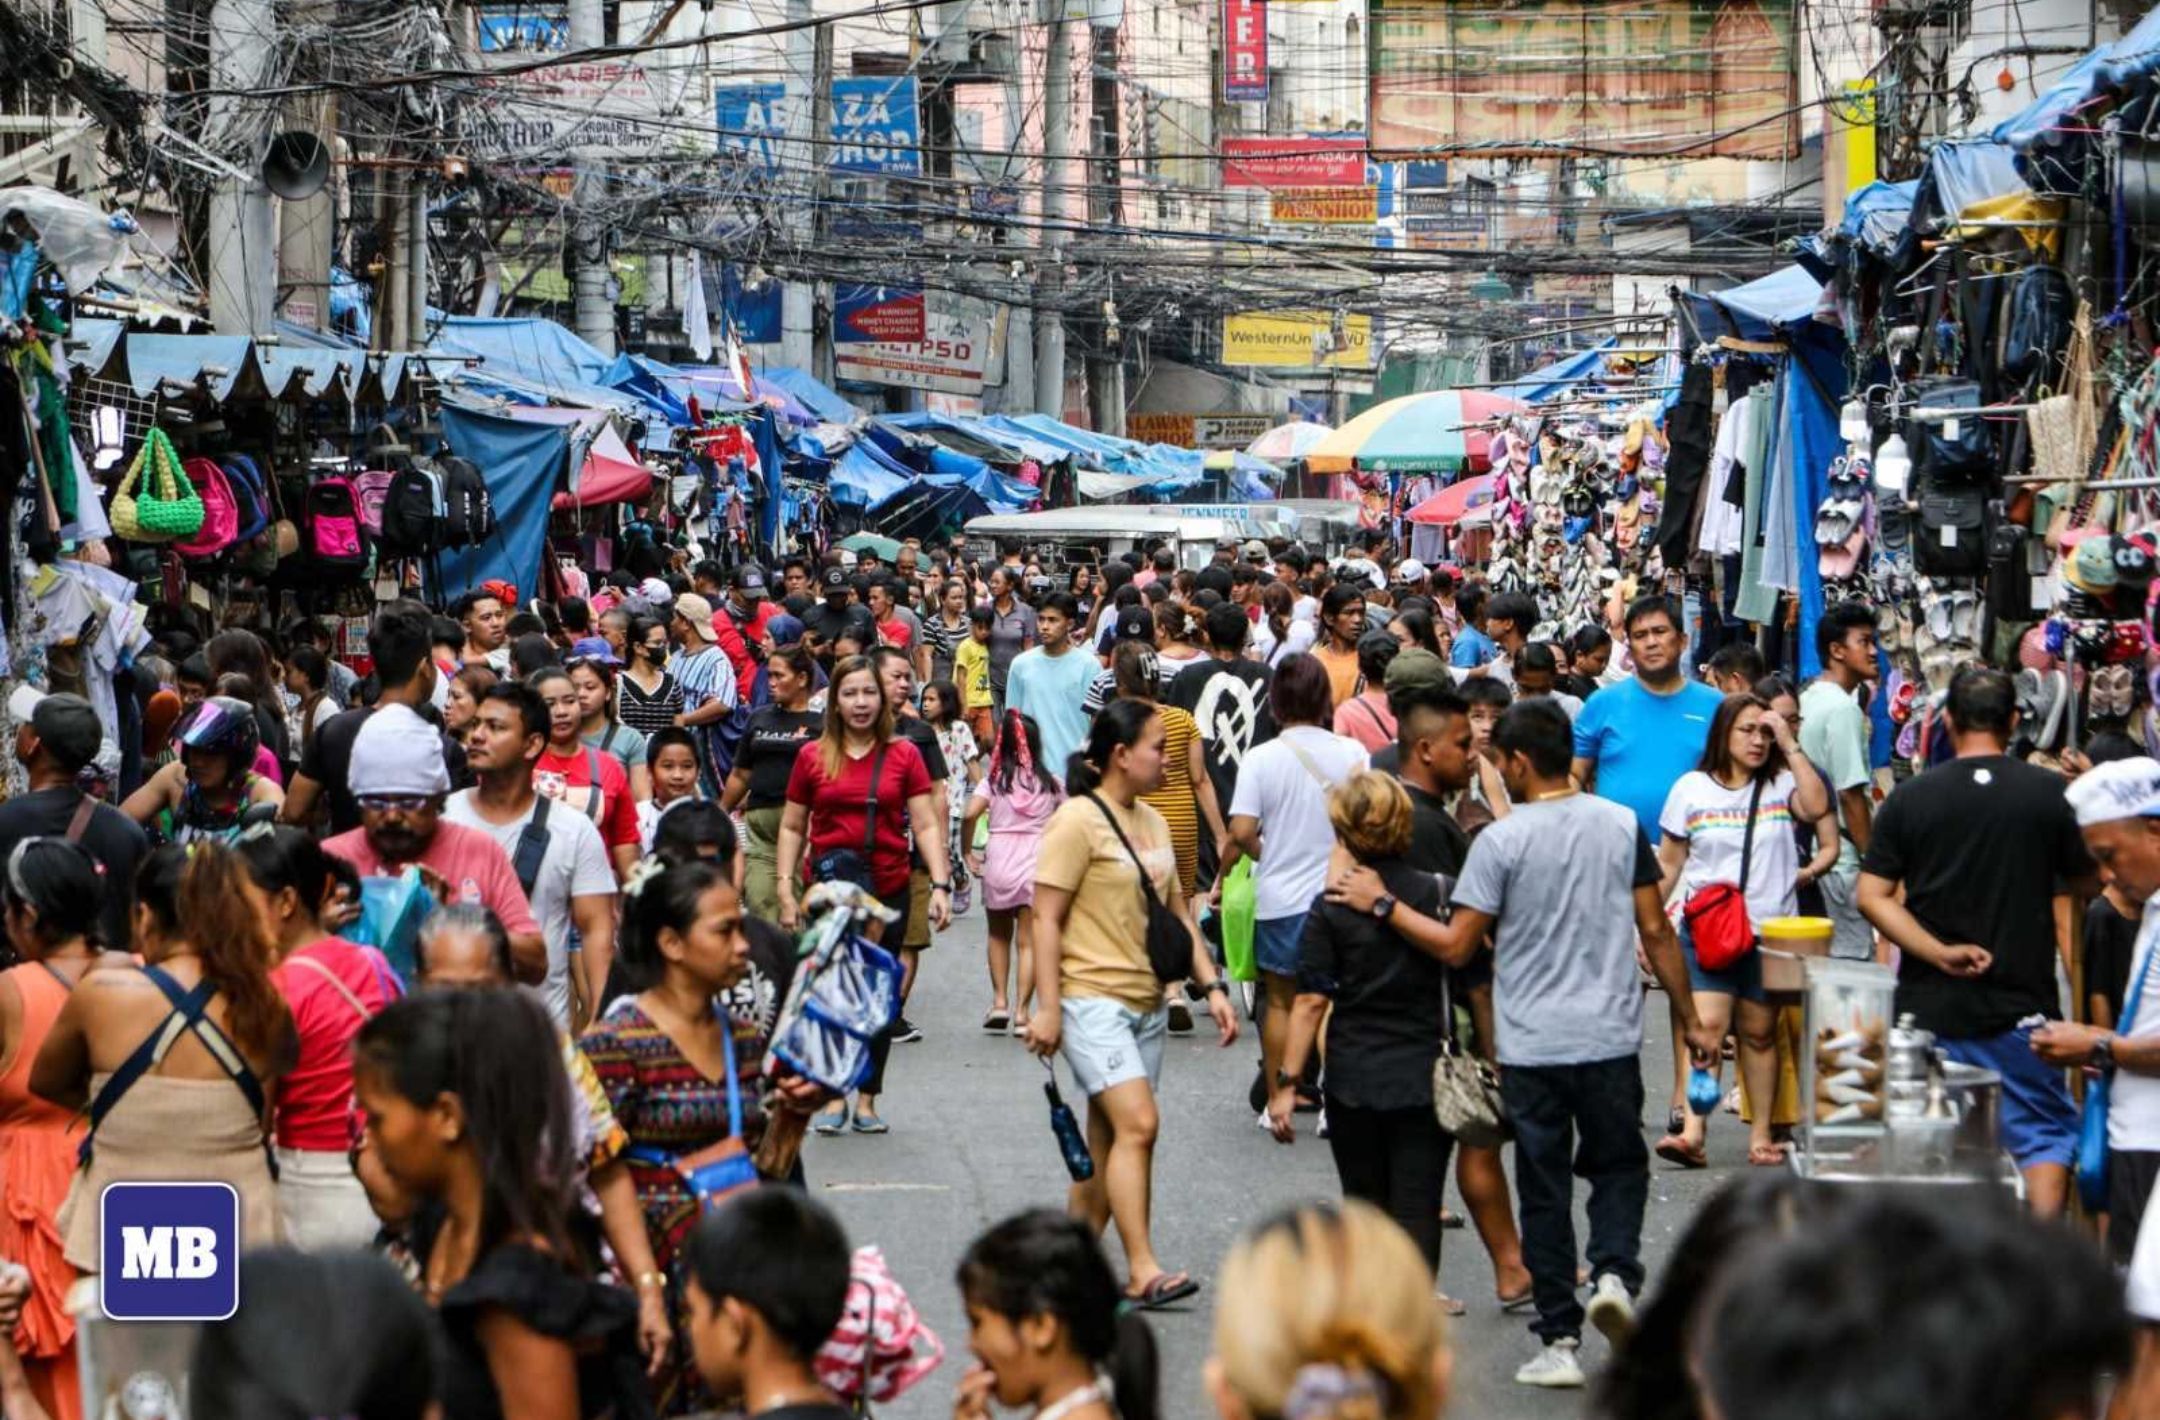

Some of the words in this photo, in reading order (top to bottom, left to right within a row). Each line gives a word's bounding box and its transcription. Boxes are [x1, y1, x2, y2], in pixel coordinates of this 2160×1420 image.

[1309, 151, 1359, 163] PADALA
[884, 317, 919, 326] CHANGER
[890, 326, 920, 335] PADALA
[1230, 331, 1313, 346] WesternUn
[1180, 507, 1248, 519] JENNIFER
